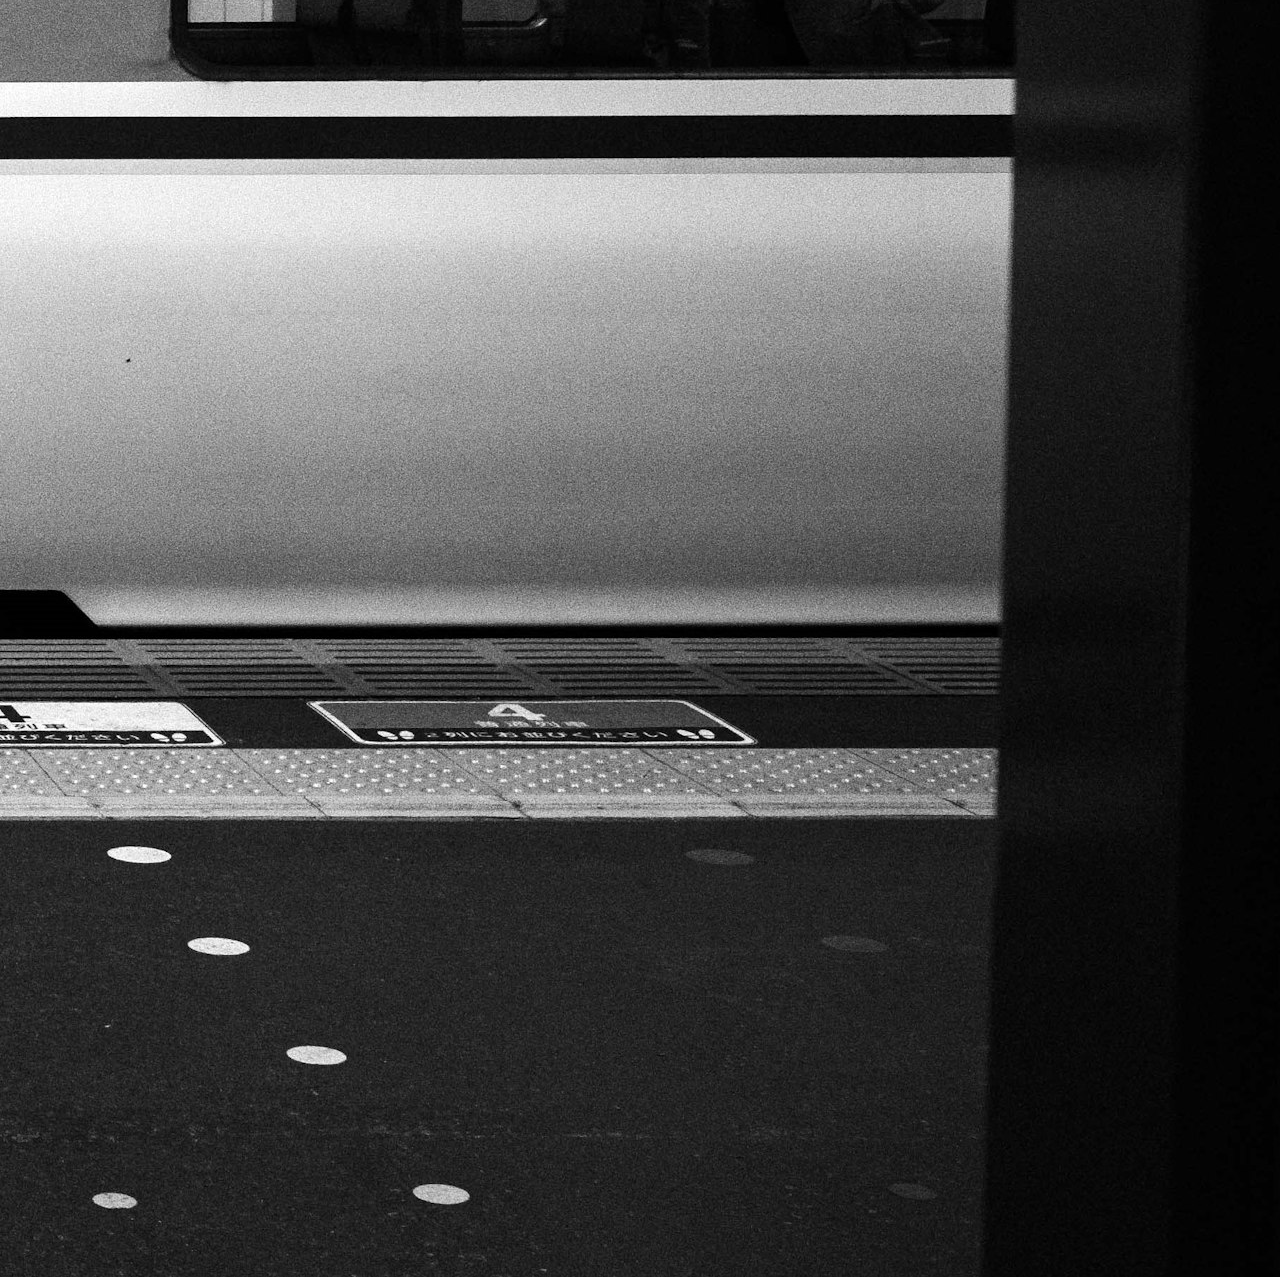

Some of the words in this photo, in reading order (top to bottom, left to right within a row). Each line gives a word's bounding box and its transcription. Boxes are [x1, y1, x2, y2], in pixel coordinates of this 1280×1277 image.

[487, 703, 546, 721] 4
[424, 731, 669, 740] 2列にお並びください
